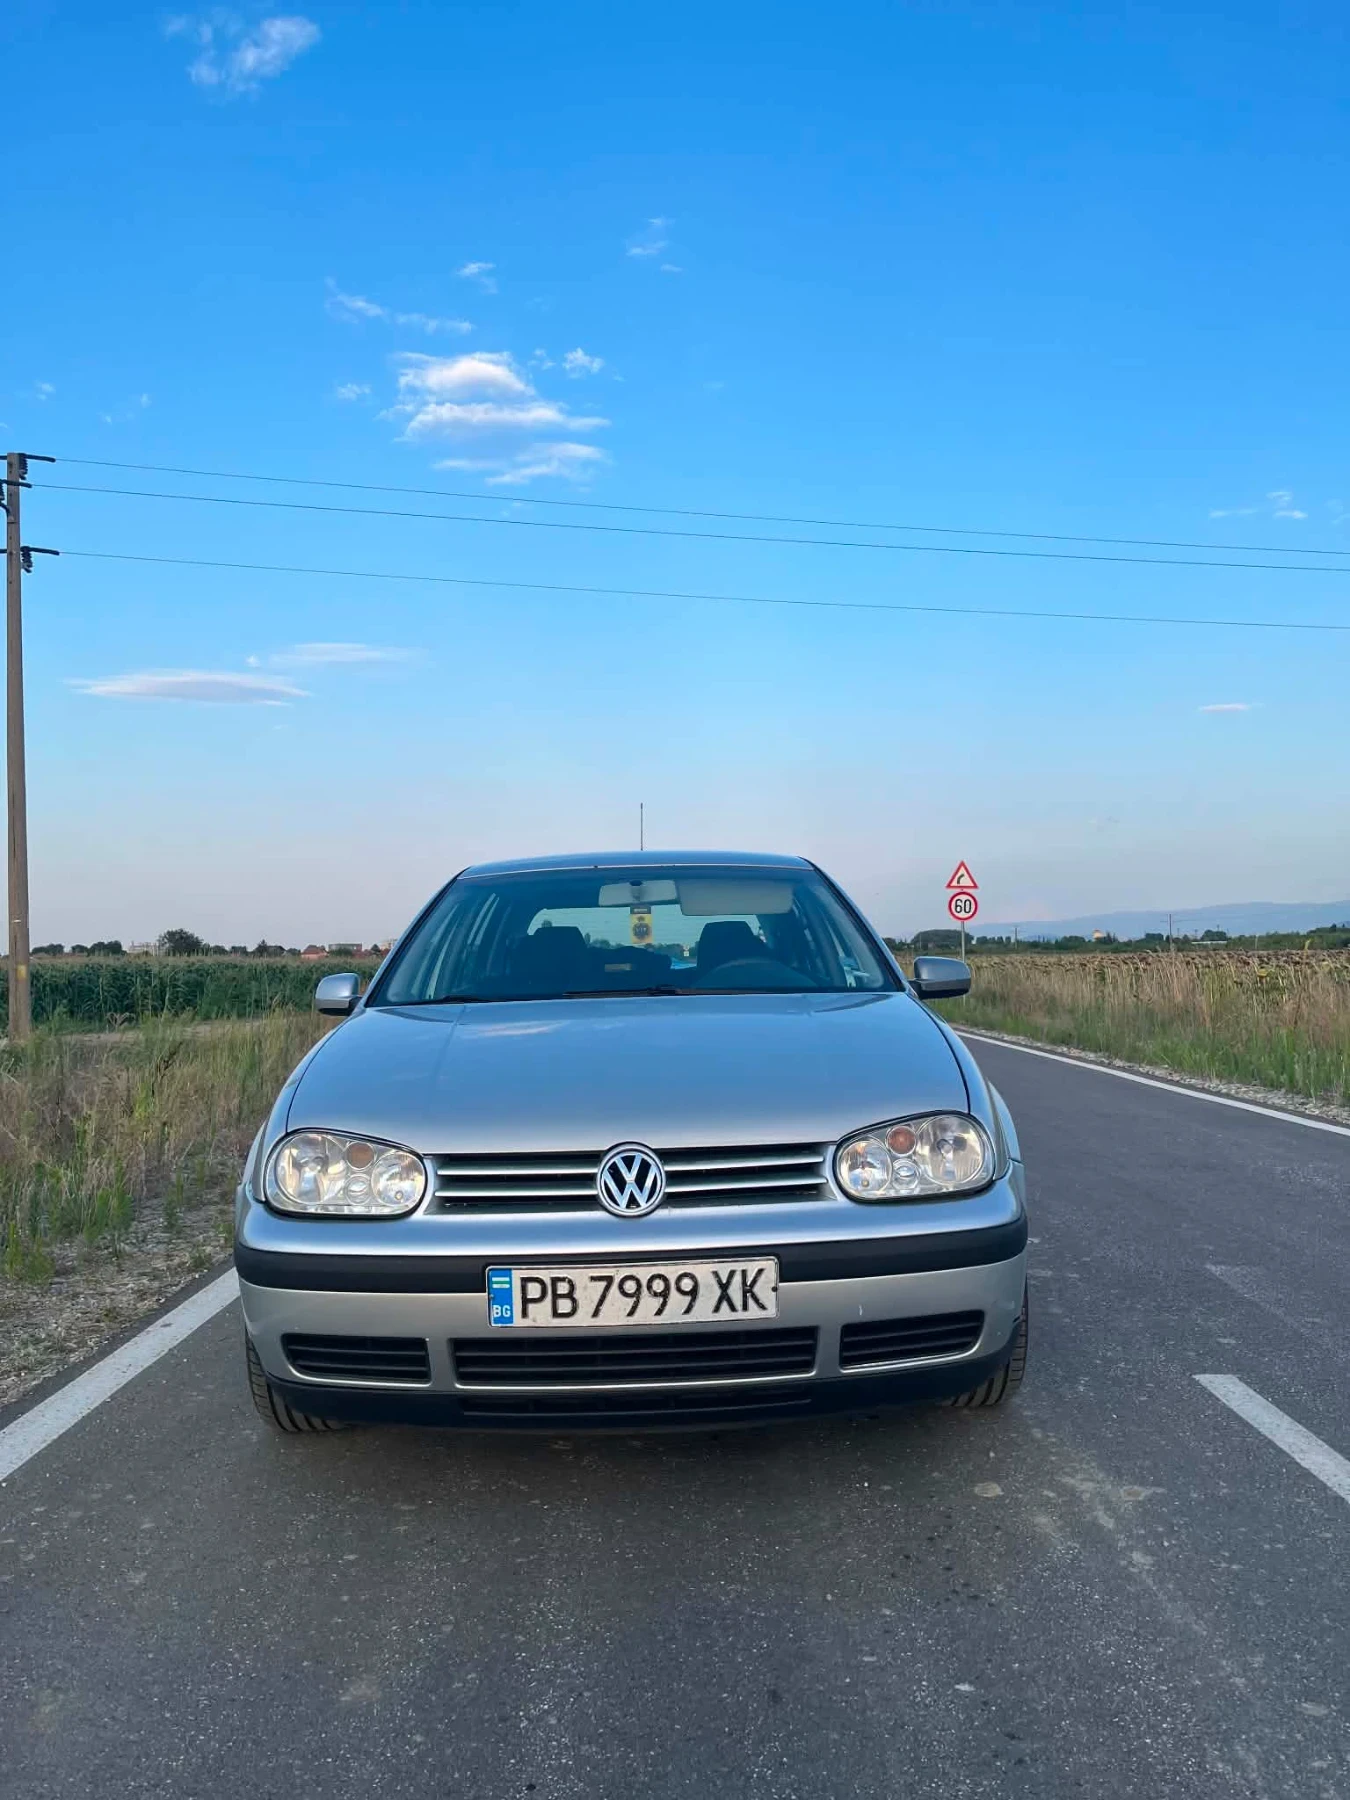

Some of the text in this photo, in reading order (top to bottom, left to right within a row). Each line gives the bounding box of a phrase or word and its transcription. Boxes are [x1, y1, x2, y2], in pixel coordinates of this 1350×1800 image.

[954, 898, 972, 914] 60
[602, 1151, 660, 1210] VW
[589, 1271, 699, 1318] 7999
[711, 1267, 768, 1314] XK
[492, 1304, 511, 1318] BG
